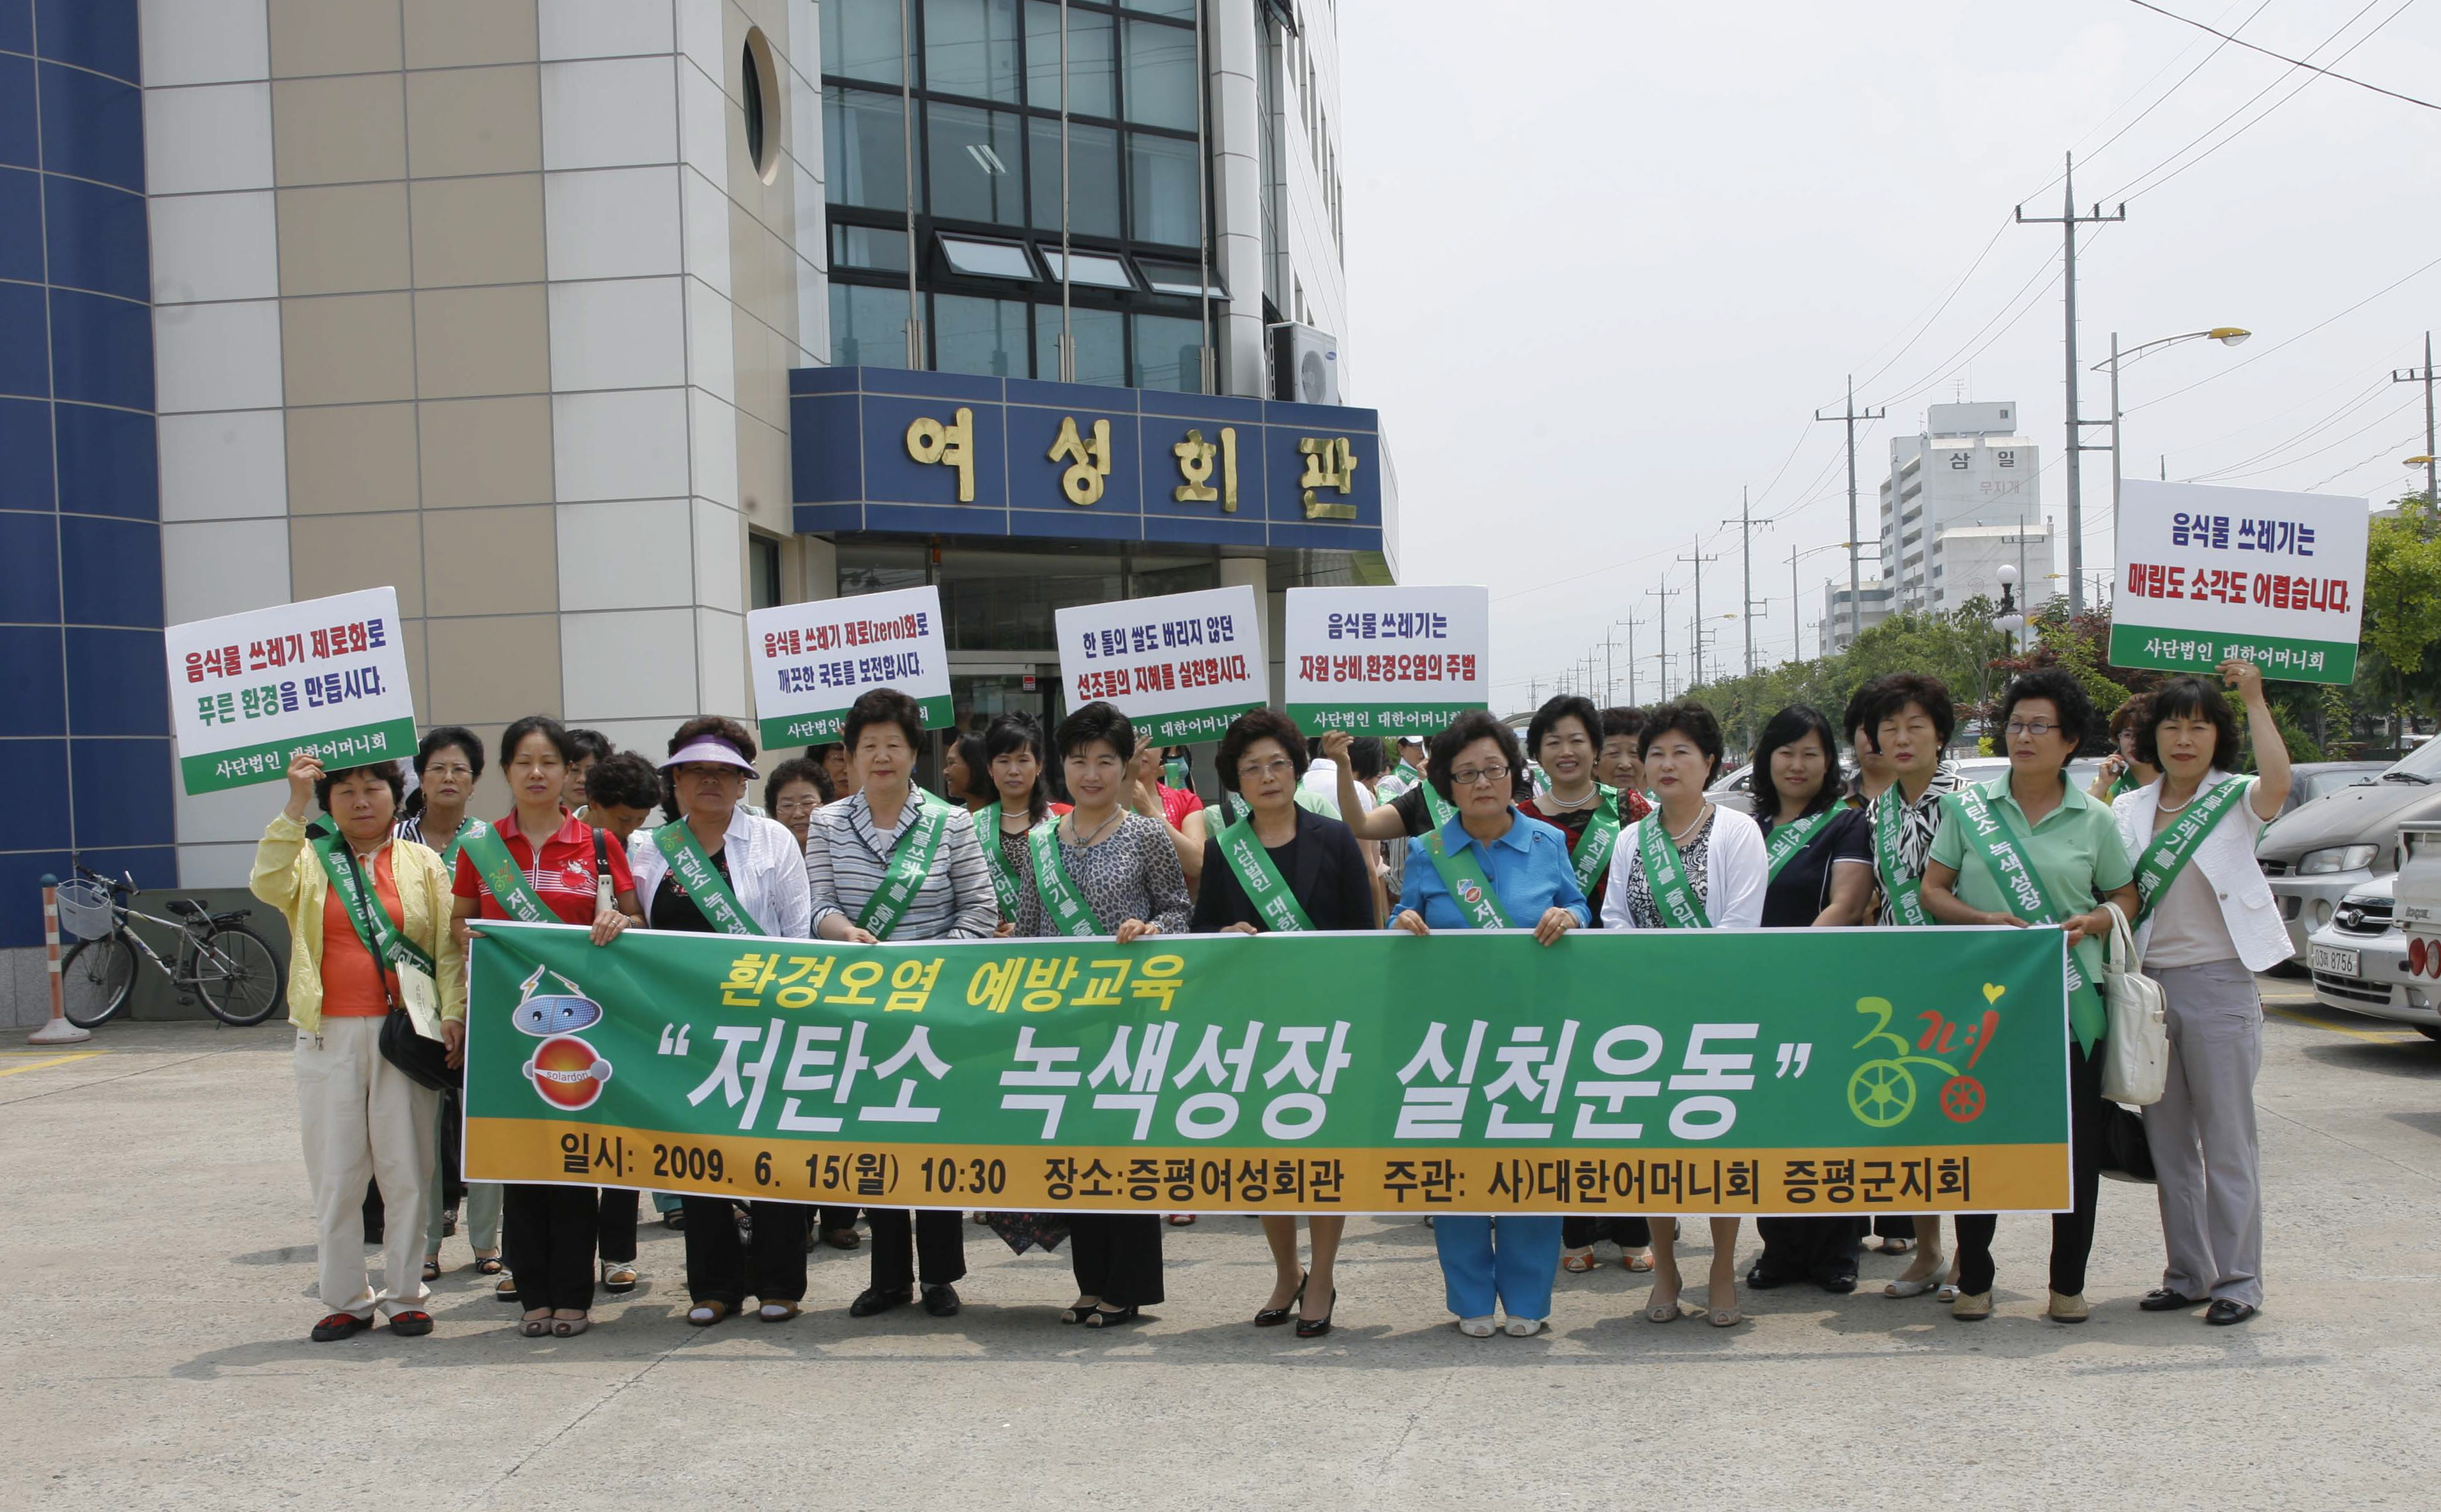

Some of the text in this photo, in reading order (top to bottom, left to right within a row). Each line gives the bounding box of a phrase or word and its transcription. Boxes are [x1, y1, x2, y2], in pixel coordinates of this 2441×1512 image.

[906, 407, 1358, 519] 여성회관
[1980, 480, 2021, 494] 무지개
[2172, 512, 2315, 556] 음식물 쓰레기는
[2128, 563, 2350, 614] 매립도 소각도 어렵습니다.
[765, 630, 801, 658] 음식물
[805, 624, 841, 652] 쓰레기
[1083, 615, 1234, 659] 한 톨의 쌀도 버리지 않던
[1328, 612, 1447, 639] 음식물 쓰레기는
[185, 618, 386, 683] 음식물 쓰레기 제로화로
[1299, 655, 1329, 682] 자원
[1446, 654, 1476, 681] 주범
[2143, 638, 2325, 672] 사단법인 대한어머니회
[778, 652, 924, 694] 깨끗한 국토를 보전합시다.
[1077, 654, 1250, 701] 선조들의 지혜를 실천합시다.
[197, 666, 386, 726] 푸른 환경을 만듭시다.
[787, 718, 843, 738] 사단법인
[1313, 712, 1370, 728] 사단법인
[215, 751, 281, 779] 사단법인
[1232, 838, 1272, 892] 사단법인
[1957, 789, 2042, 911] 저탄소 녹색성장
[674, 846, 754, 935] 저탄소 녹색성
[720, 952, 1185, 1013] 환경오염 예방교육
[2331, 952, 2352, 972] 8756
[547, 1071, 588, 1081] solardon
[999, 1020, 1352, 1141] 녹색성장
[560, 1133, 634, 1177] 일시:
[653, 1144, 733, 1184] 2009.
[754, 1151, 781, 1187] 6.
[805, 1152, 899, 1196] 15(월)
[921, 1157, 1006, 1195] 10:30
[1383, 1159, 1466, 1205] 주관:
[1487, 1157, 1761, 1205] 사)대한어머니회
[1782, 1156, 1971, 1203] 증평군지회
